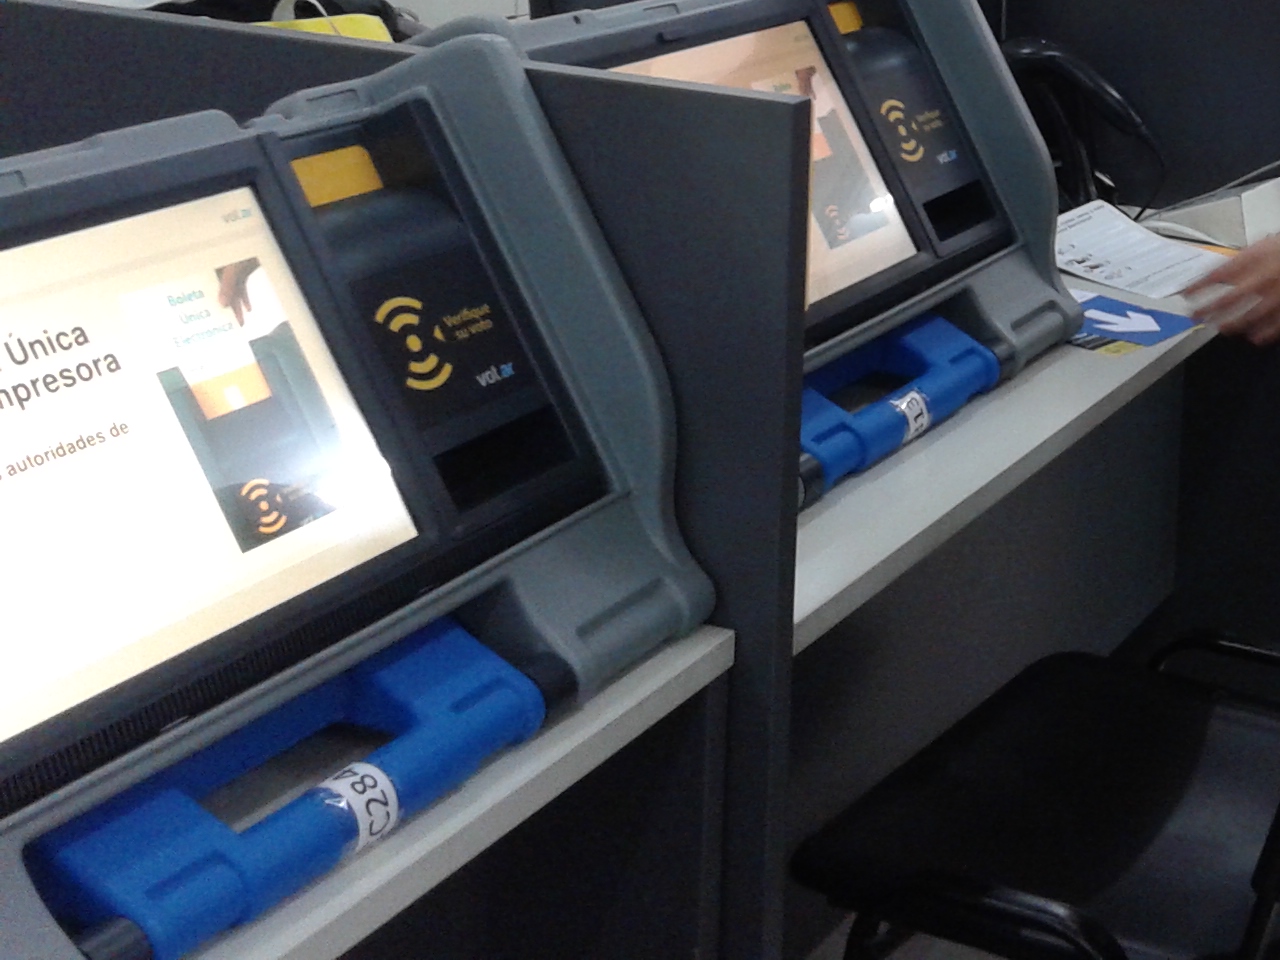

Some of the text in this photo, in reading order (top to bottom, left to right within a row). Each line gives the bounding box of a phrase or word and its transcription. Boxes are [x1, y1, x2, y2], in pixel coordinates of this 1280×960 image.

[3, 326, 91, 367] Única
[5, 422, 130, 477] autoridades de
